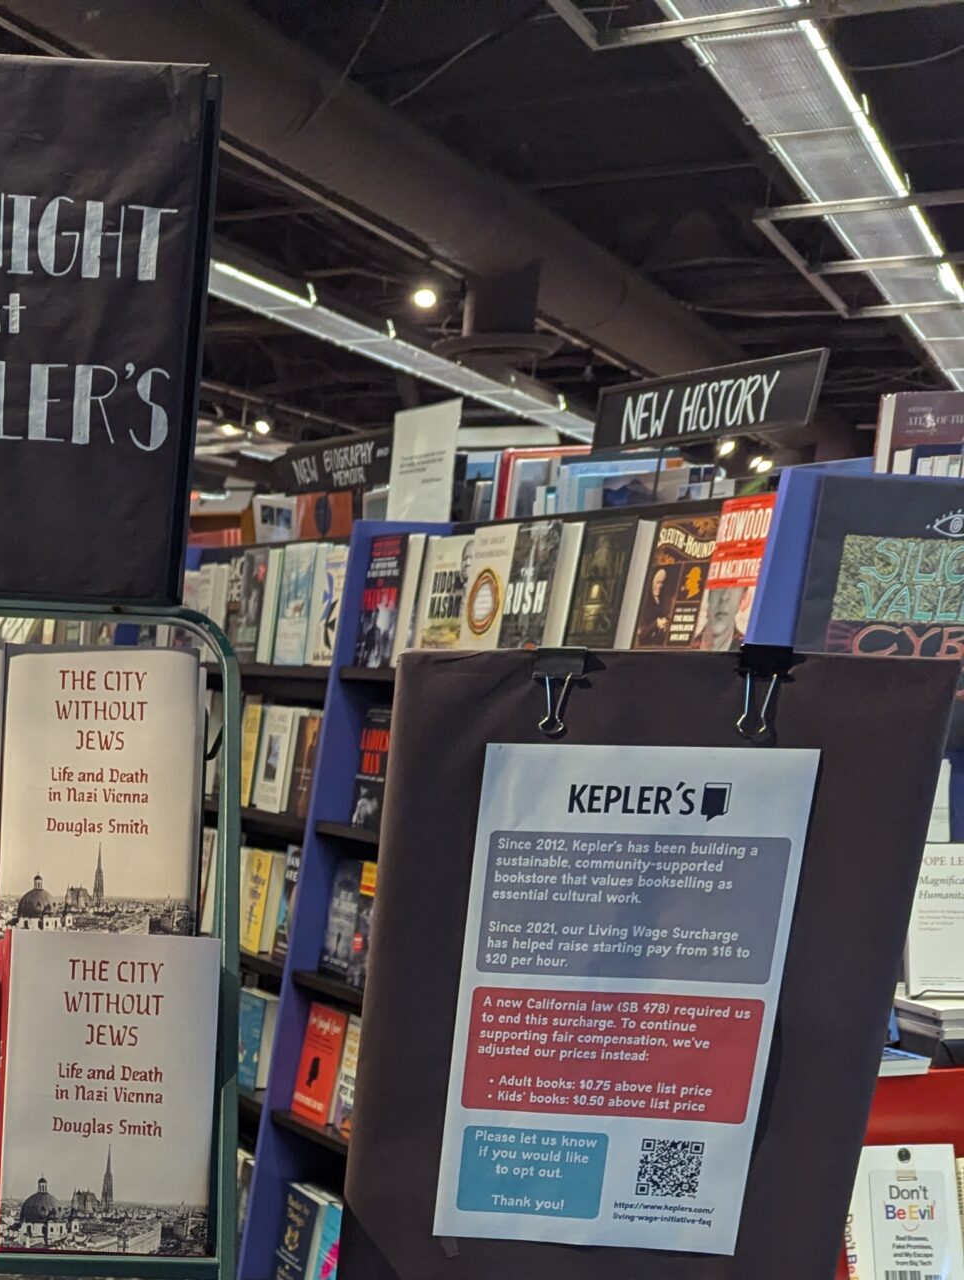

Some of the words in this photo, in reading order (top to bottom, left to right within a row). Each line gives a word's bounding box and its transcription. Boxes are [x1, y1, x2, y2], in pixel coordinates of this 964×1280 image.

[620, 390, 673, 444] NEW
[677, 371, 781, 434] HISTORY
[291, 455, 318, 486] NEW
[322, 441, 375, 473] BIOGRAPHY
[332, 464, 366, 487] MEMOIR
[503, 579, 549, 615] RUSH
[568, 780, 697, 816] KEPLER'S
[497, 838, 531, 851] Since
[536, 838, 569, 853] 2012,
[572, 840, 623, 855] Kepler's
[627, 842, 650, 854] has
[654, 843, 686, 856] been
[690, 843, 746, 859] building
[750, 847, 759, 856] a
[495, 855, 572, 870] sustainable,
[575, 858, 724, 874] community-supported
[494, 871, 557, 886] bookstore
[561, 873, 586, 887] that
[590, 875, 634, 888] values
[637, 875, 713, 891] bookselling
[717, 880, 733, 891] as
[492, 888, 548, 902] essential
[552, 890, 602, 904] cultural
[606, 891, 642, 905] work.
[498, 1074, 533, 1089] Adult
[536, 1076, 576, 1091] books:
[579, 1078, 611, 1094] $0.75
[614, 1080, 653, 1095] above
[656, 1081, 677, 1096] list
[679, 1083, 712, 1099] price
[474, 1129, 516, 1146] Please
[520, 1133, 537, 1147] let
[541, 1135, 558, 1147] us
[561, 1135, 598, 1150] know
[478, 1146, 488, 1159] if
[491, 1149, 517, 1164] you
[521, 1149, 561, 1163] would
[565, 1151, 589, 1164] like
[495, 1164, 509, 1176] to
[511, 1164, 535, 1180] opt
[538, 1166, 564, 1179] out.
[888, 1185, 929, 1201] Don't
[491, 1194, 531, 1209] Thank
[535, 1196, 565, 1212] you!
[613, 1201, 715, 1214] https://www.keplers.com/
[885, 1204, 907, 1220] Be
[909, 1204, 934, 1220] Evil
[613, 1212, 712, 1227] living-wage-initiative-faq
